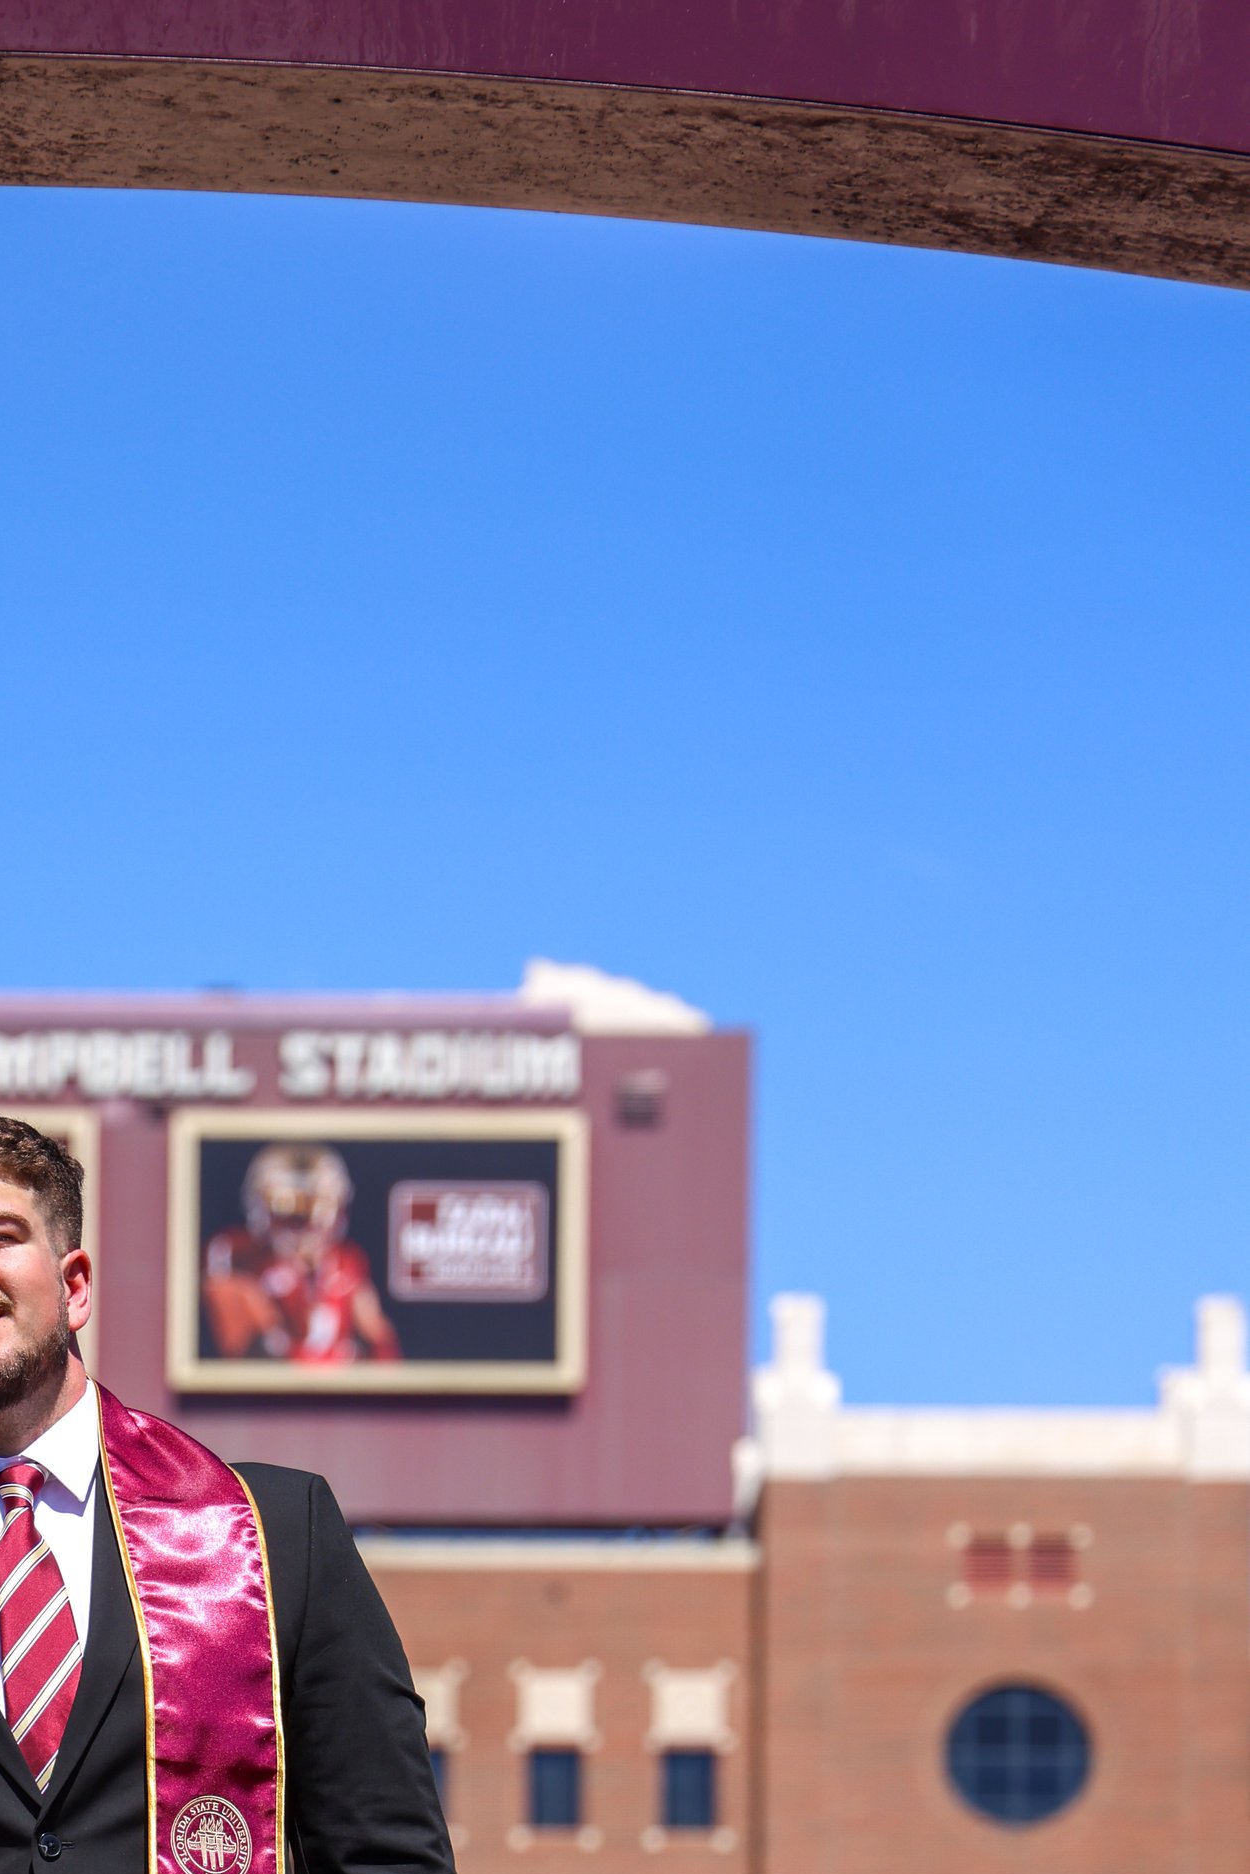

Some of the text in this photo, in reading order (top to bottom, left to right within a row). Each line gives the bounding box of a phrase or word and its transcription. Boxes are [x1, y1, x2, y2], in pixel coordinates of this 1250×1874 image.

[277, 1030, 582, 1100] STADIUM
[176, 1802, 248, 1869] FLORIDA STATE UNIVERSITY
